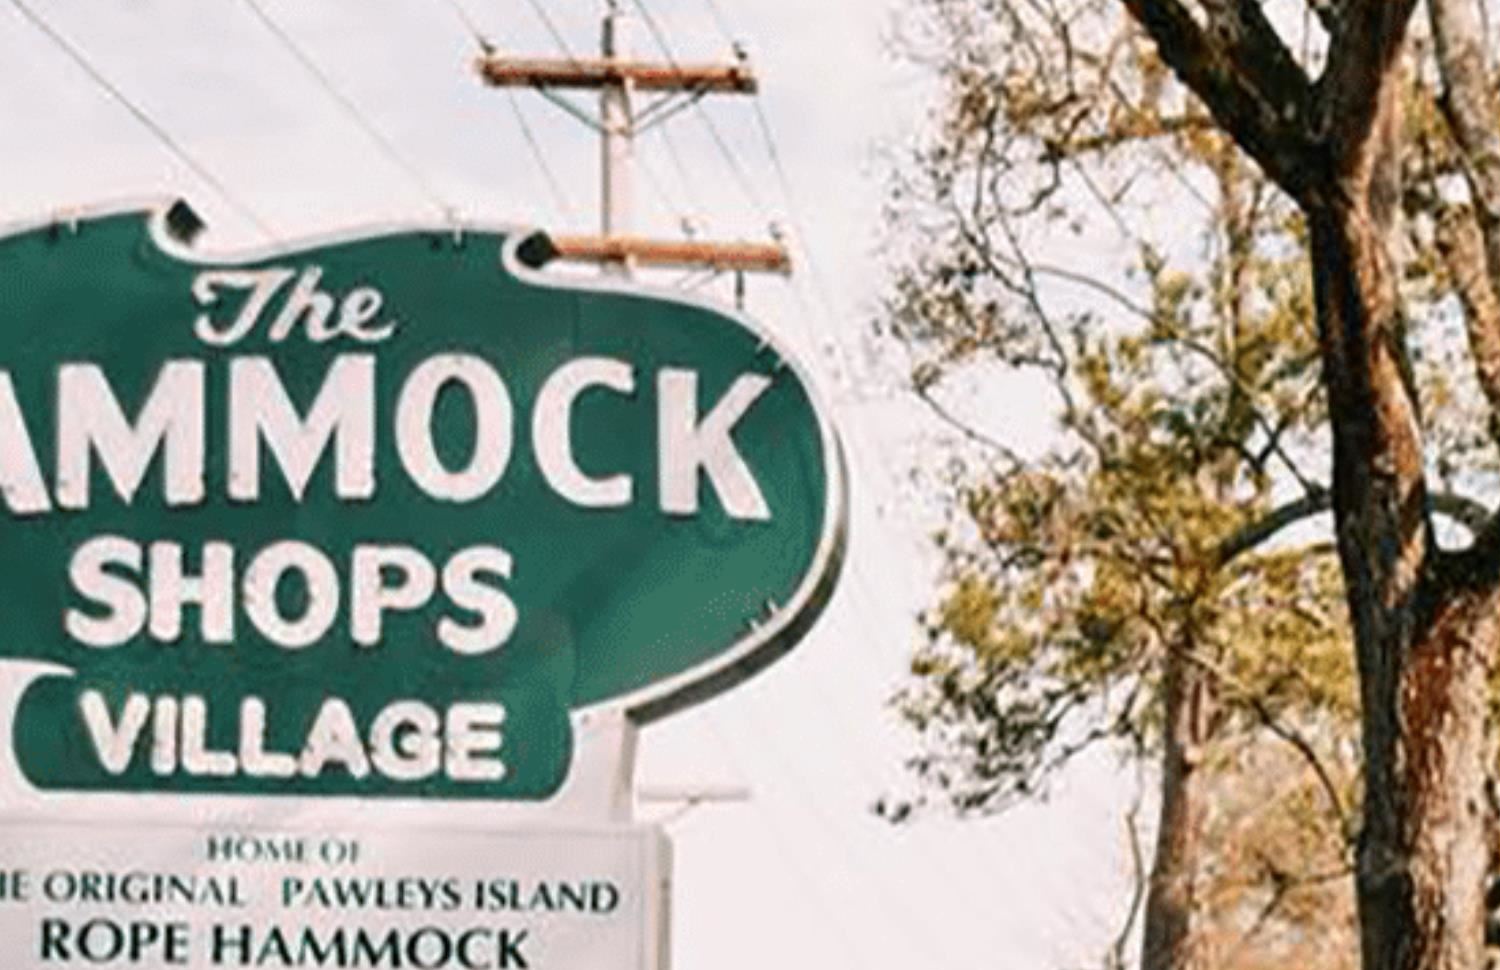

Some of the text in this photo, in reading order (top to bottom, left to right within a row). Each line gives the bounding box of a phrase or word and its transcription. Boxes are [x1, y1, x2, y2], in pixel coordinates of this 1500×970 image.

[192, 265, 397, 346] The
[64, 535, 519, 656] SHOPS
[79, 689, 507, 782] VILLAGE
[206, 836, 304, 863] HOME
[43, 871, 246, 907] ORIGINAL
[282, 876, 462, 910] PAWLEYS
[475, 878, 619, 914] ISLAND
[40, 917, 190, 965] ROPE
